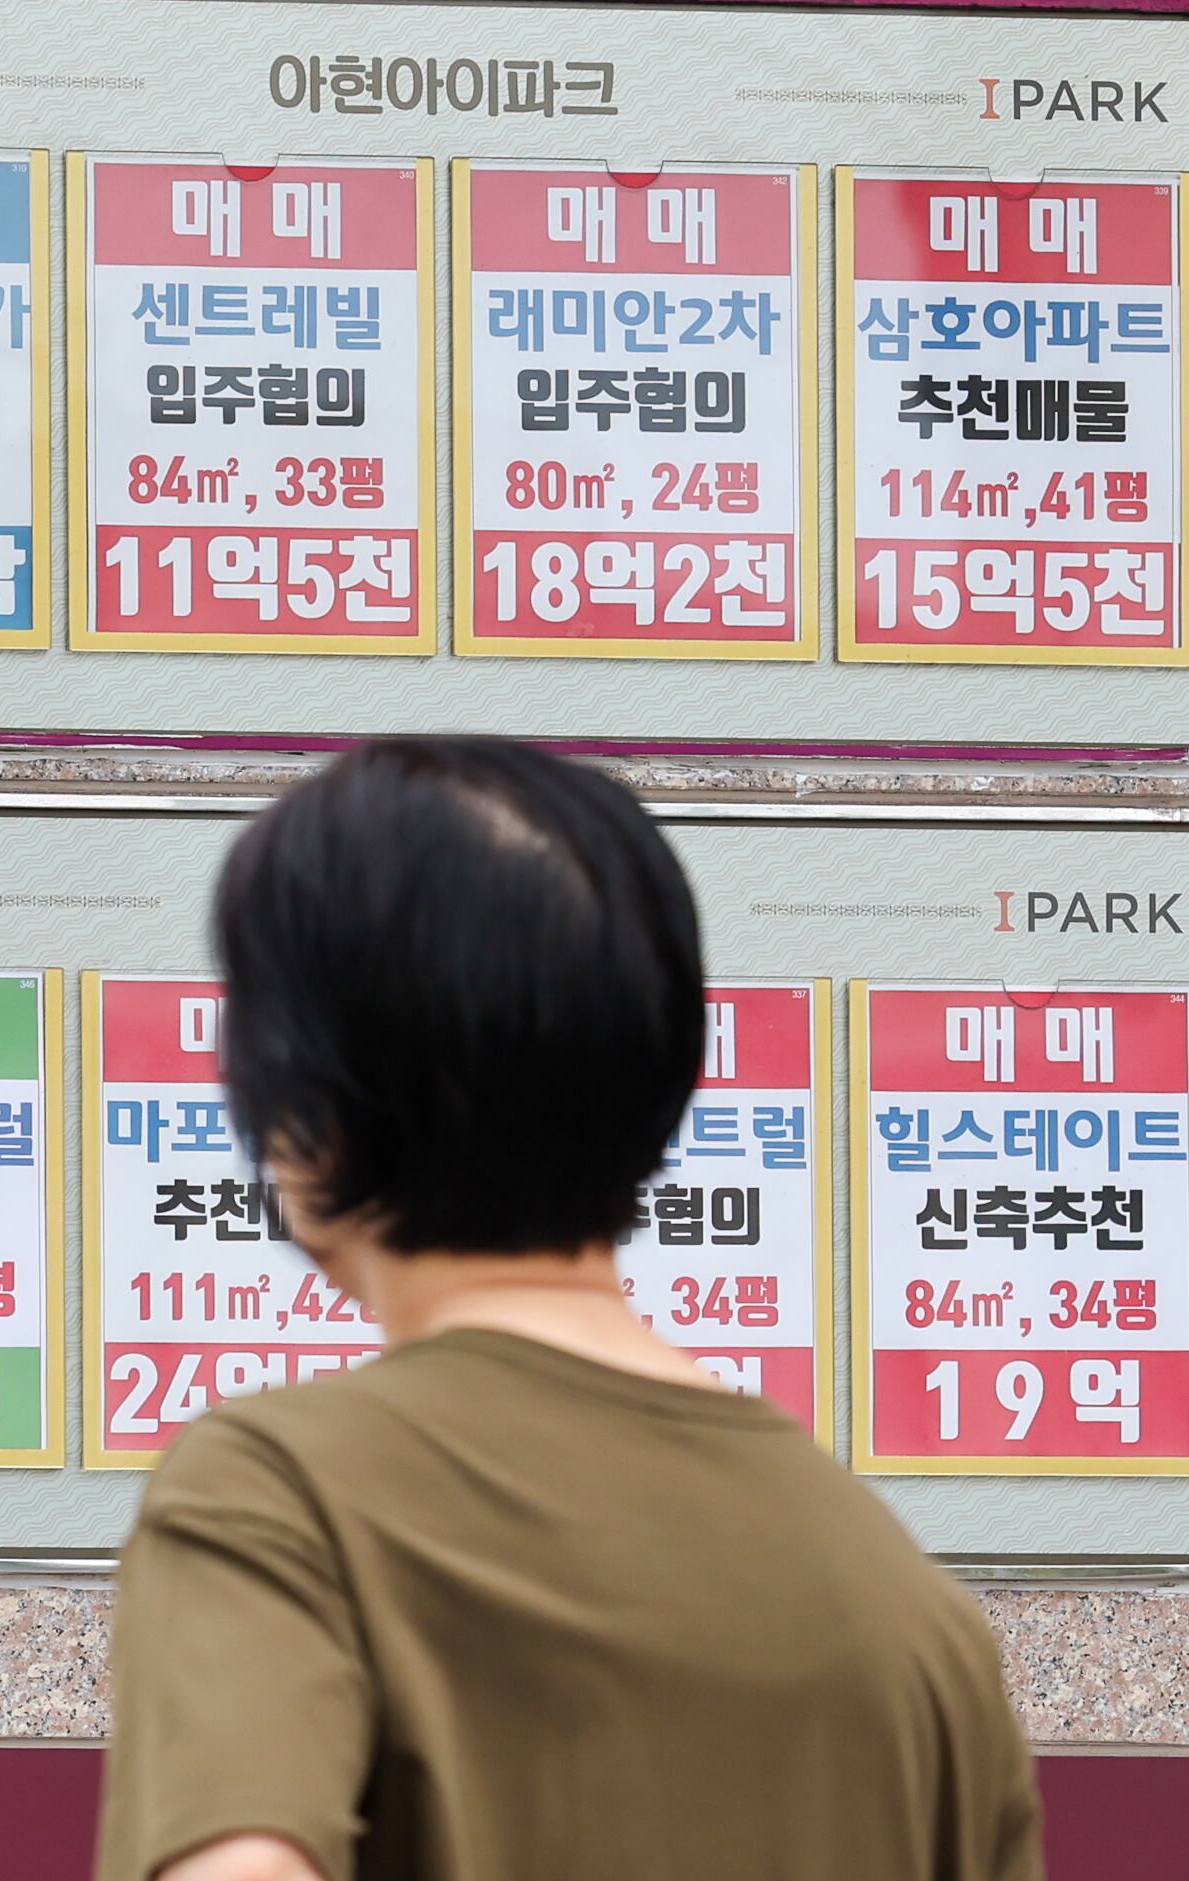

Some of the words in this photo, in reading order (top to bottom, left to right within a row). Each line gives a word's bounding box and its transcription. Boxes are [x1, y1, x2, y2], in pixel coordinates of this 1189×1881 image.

[269, 54, 619, 119] 아현아이파크
[131, 282, 382, 351] 센트레빌
[488, 288, 781, 356] 래미안2차
[858, 296, 1171, 364] 삼호아파트
[146, 363, 366, 428] 입주협의
[516, 366, 746, 434] 입주협의
[898, 374, 1129, 443] 추천매물
[105, 535, 411, 622] 11억5천
[483, 539, 786, 627] 18억2천
[864, 548, 1165, 636] 15억5천
[875, 1106, 1188, 1173] 힐스테이트
[915, 1185, 1144, 1251] 신축추천
